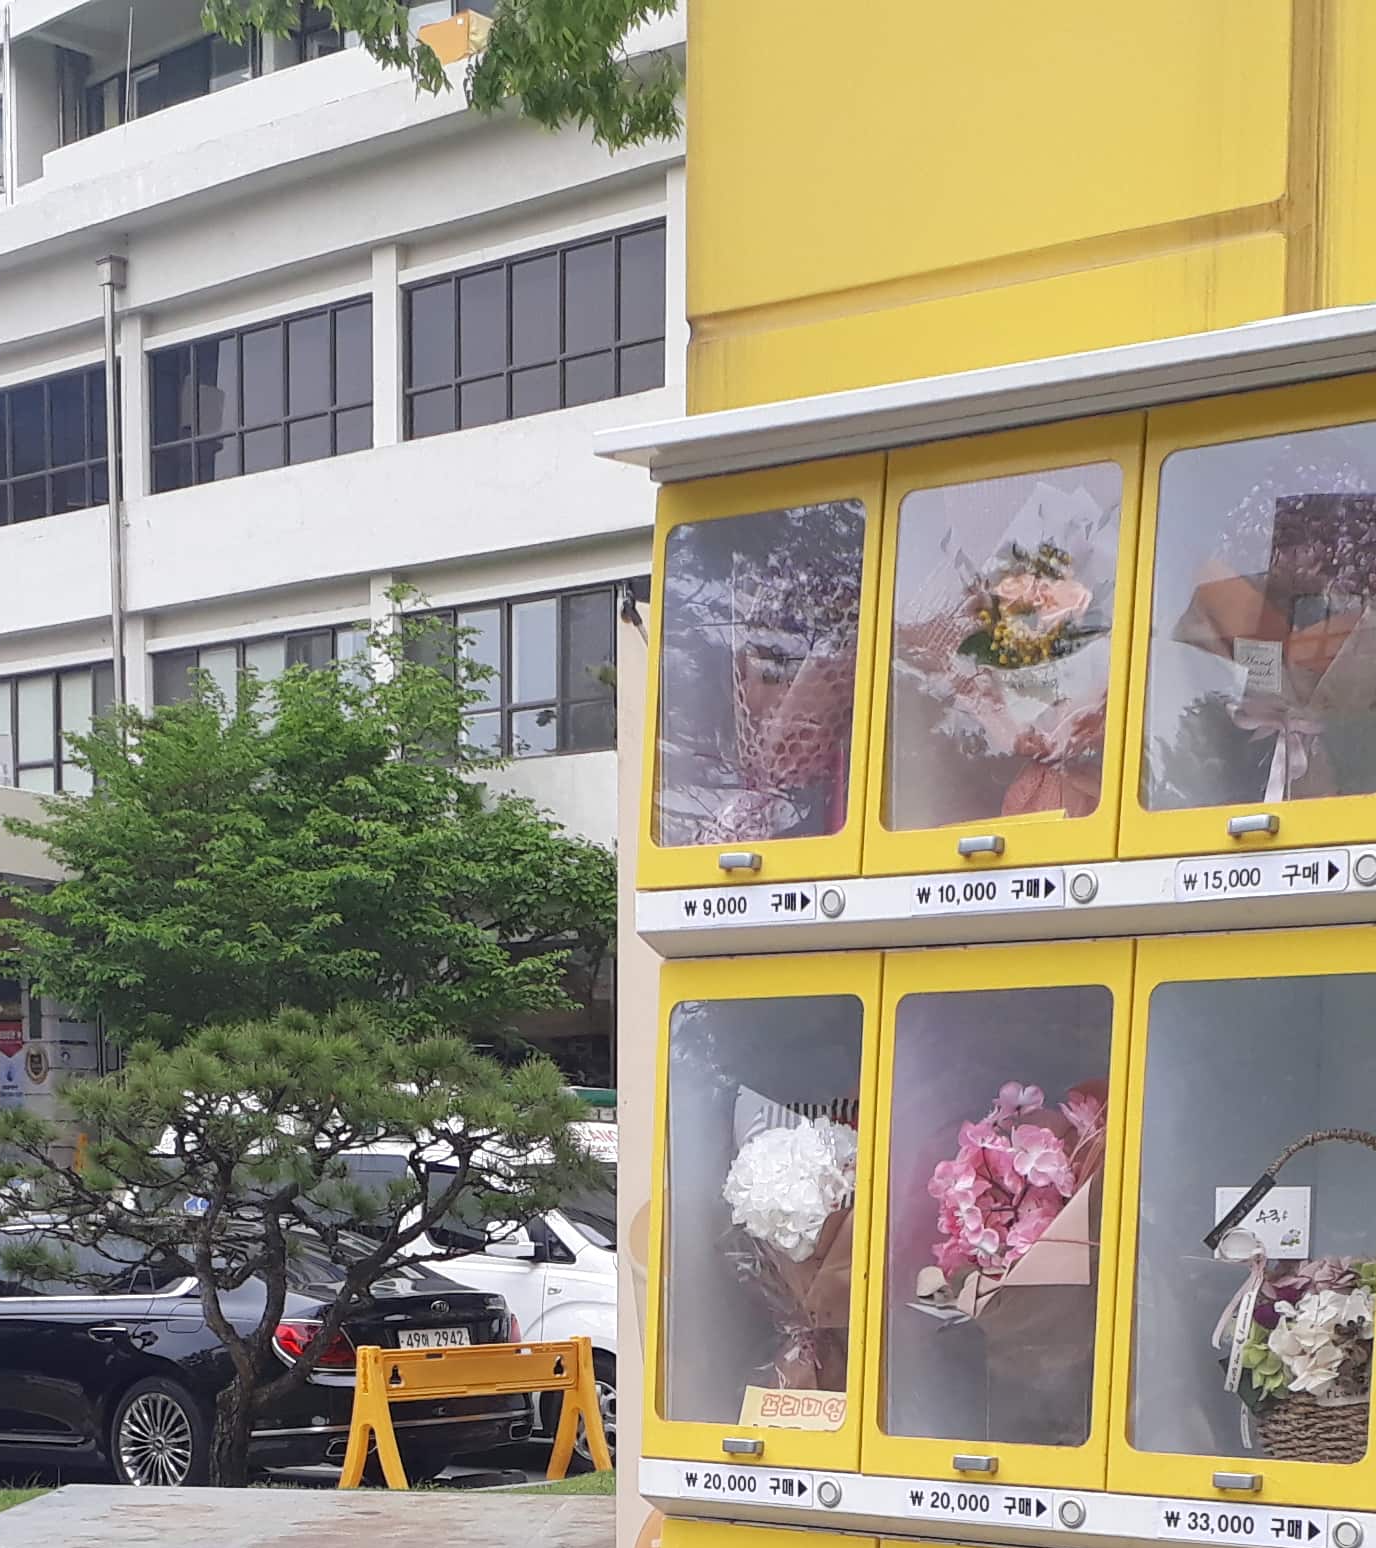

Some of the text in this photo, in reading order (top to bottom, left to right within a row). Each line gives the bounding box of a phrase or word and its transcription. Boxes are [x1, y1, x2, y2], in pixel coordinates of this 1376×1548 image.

[1184, 862, 1318, 891] ₩ 15,000 구매
[917, 879, 1039, 904] ₩ 10,000 구매
[685, 893, 796, 917] ₩ 9,000 구매
[435, 1330, 464, 1347] 2942
[686, 1473, 793, 1496] ₩ 20,000 구매
[911, 1491, 1031, 1516] ₩ 20,000 구매
[1165, 1511, 1302, 1539] ₩ 33,000 구매
